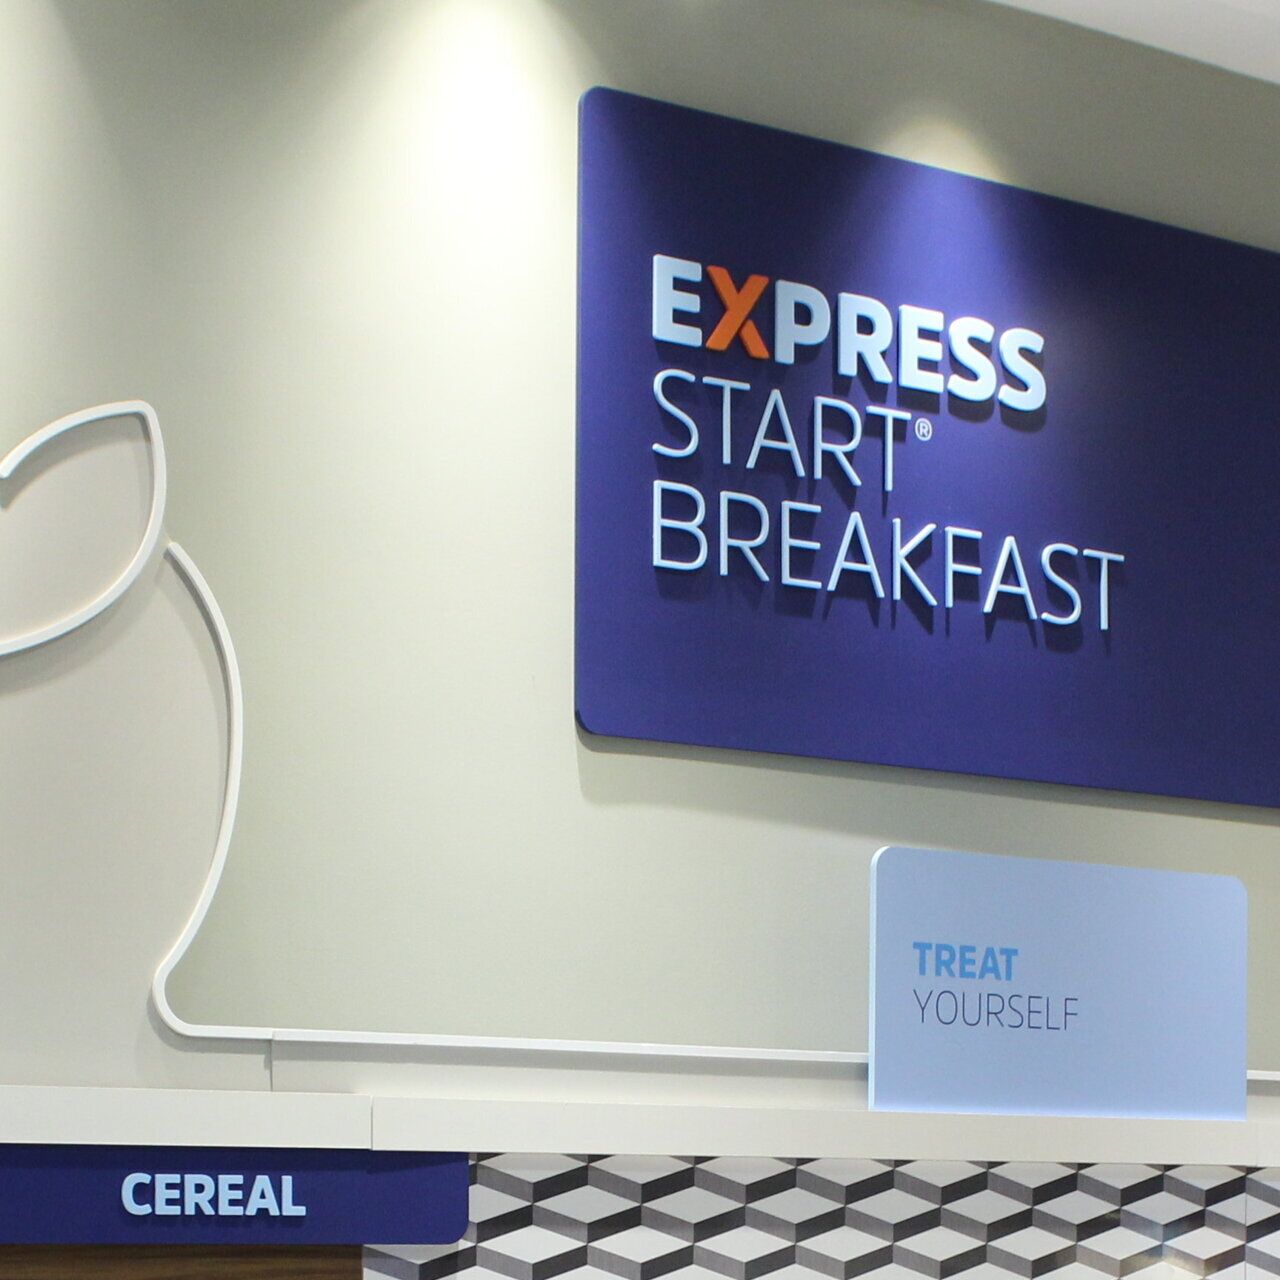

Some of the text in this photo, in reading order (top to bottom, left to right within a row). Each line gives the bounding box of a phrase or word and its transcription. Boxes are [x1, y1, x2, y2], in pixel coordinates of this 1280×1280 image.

[652, 253, 1047, 412] EXPRESS
[652, 479, 1125, 631] BREAKFAST
[912, 941, 1019, 981] TREAT
[913, 988, 1079, 1032] YOURSELF
[121, 1172, 307, 1217] CEREAL
